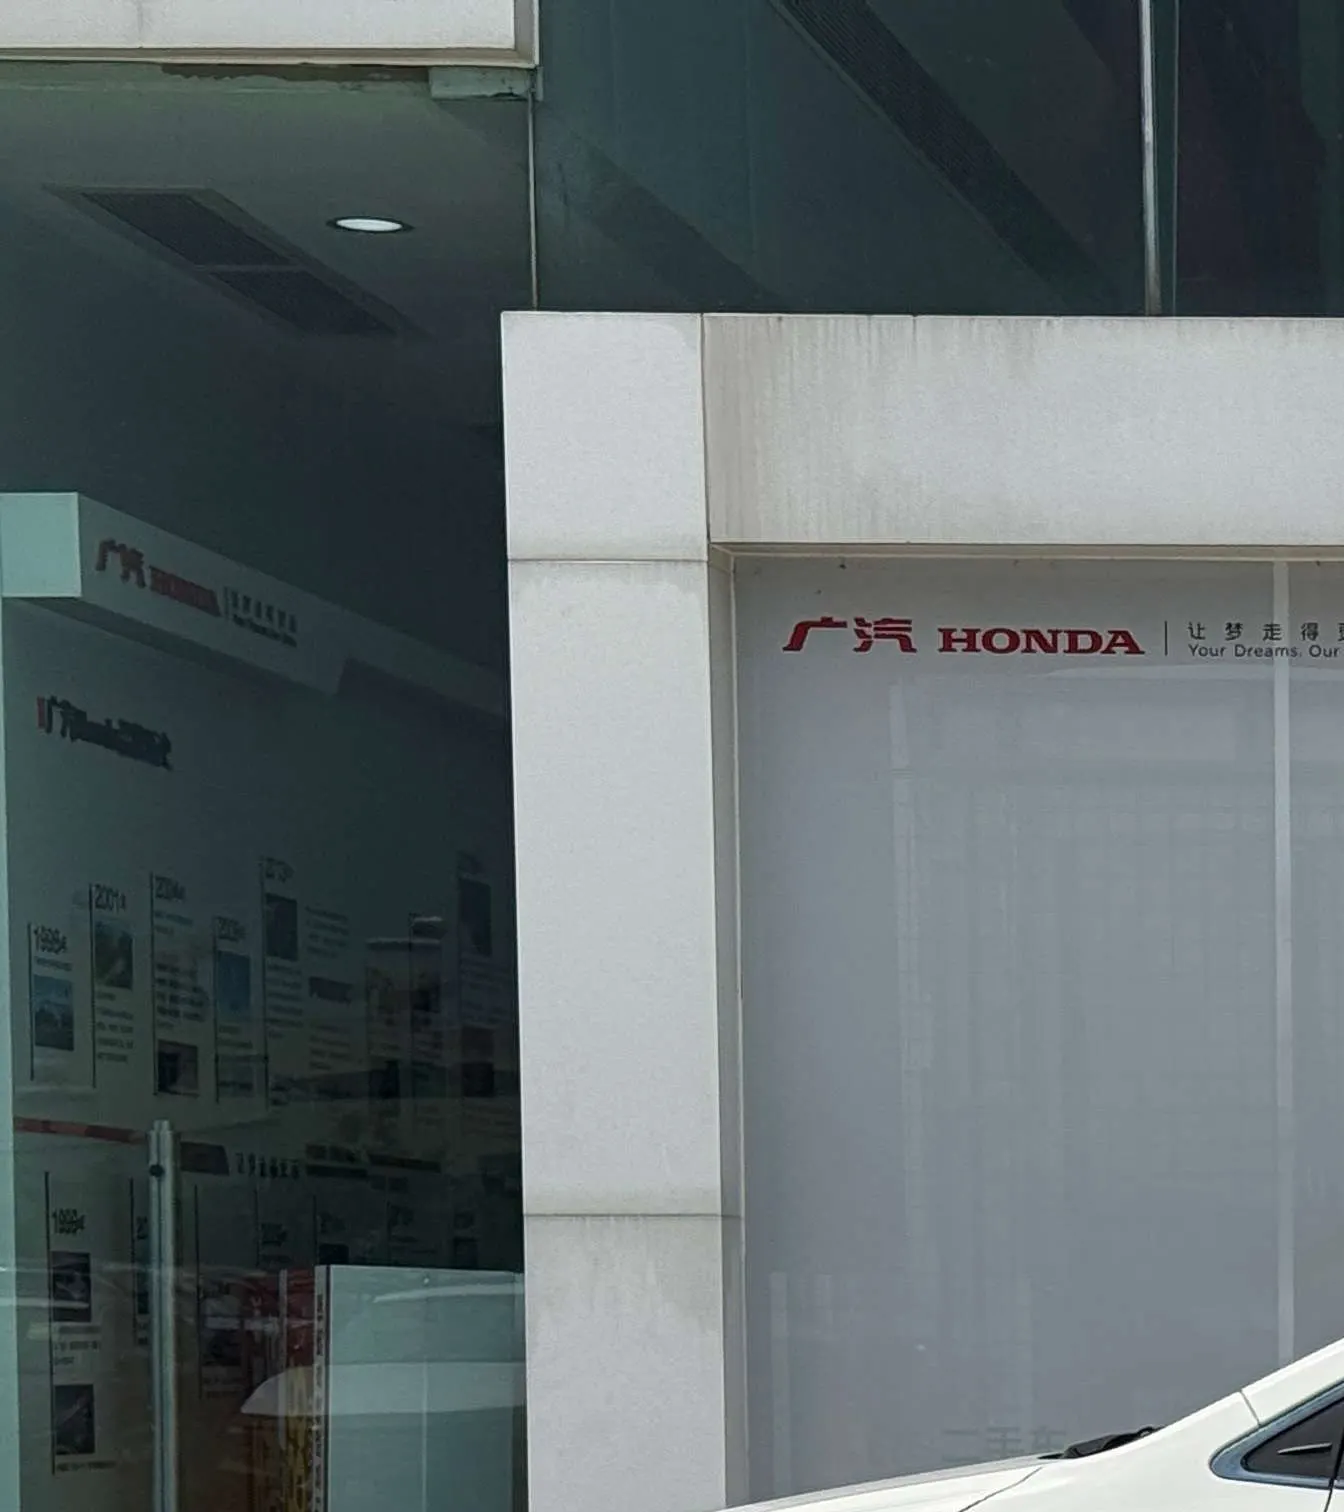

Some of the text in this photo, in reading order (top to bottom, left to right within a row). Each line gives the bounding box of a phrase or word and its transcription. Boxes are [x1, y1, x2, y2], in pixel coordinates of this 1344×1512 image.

[783, 617, 1146, 655] 广汽 HONDA
[1188, 644, 1227, 658] Your
[1309, 644, 1340, 658] Our
